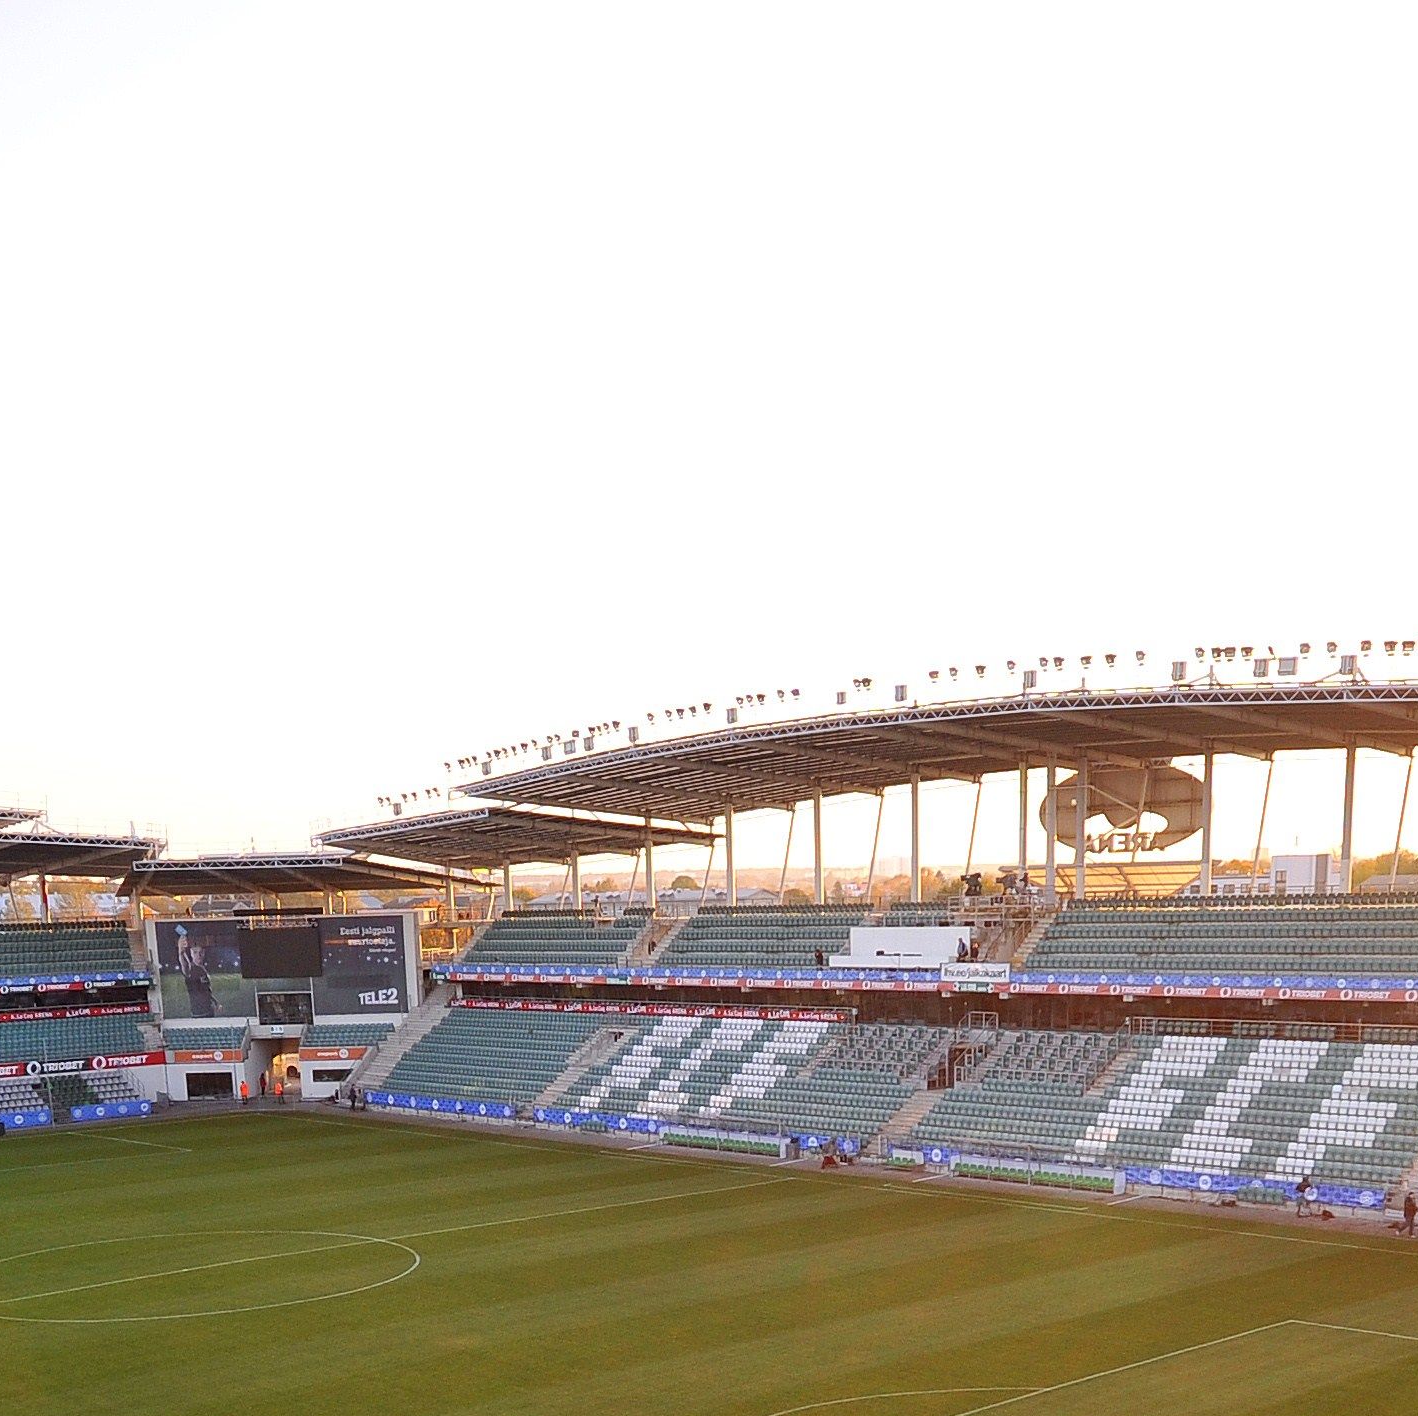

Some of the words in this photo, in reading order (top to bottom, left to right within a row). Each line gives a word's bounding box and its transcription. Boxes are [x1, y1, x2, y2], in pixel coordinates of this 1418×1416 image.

[358, 988, 399, 1005] TELE2
[42, 1060, 86, 1072] TRIOBET
[107, 1054, 149, 1066] TRIOBET
